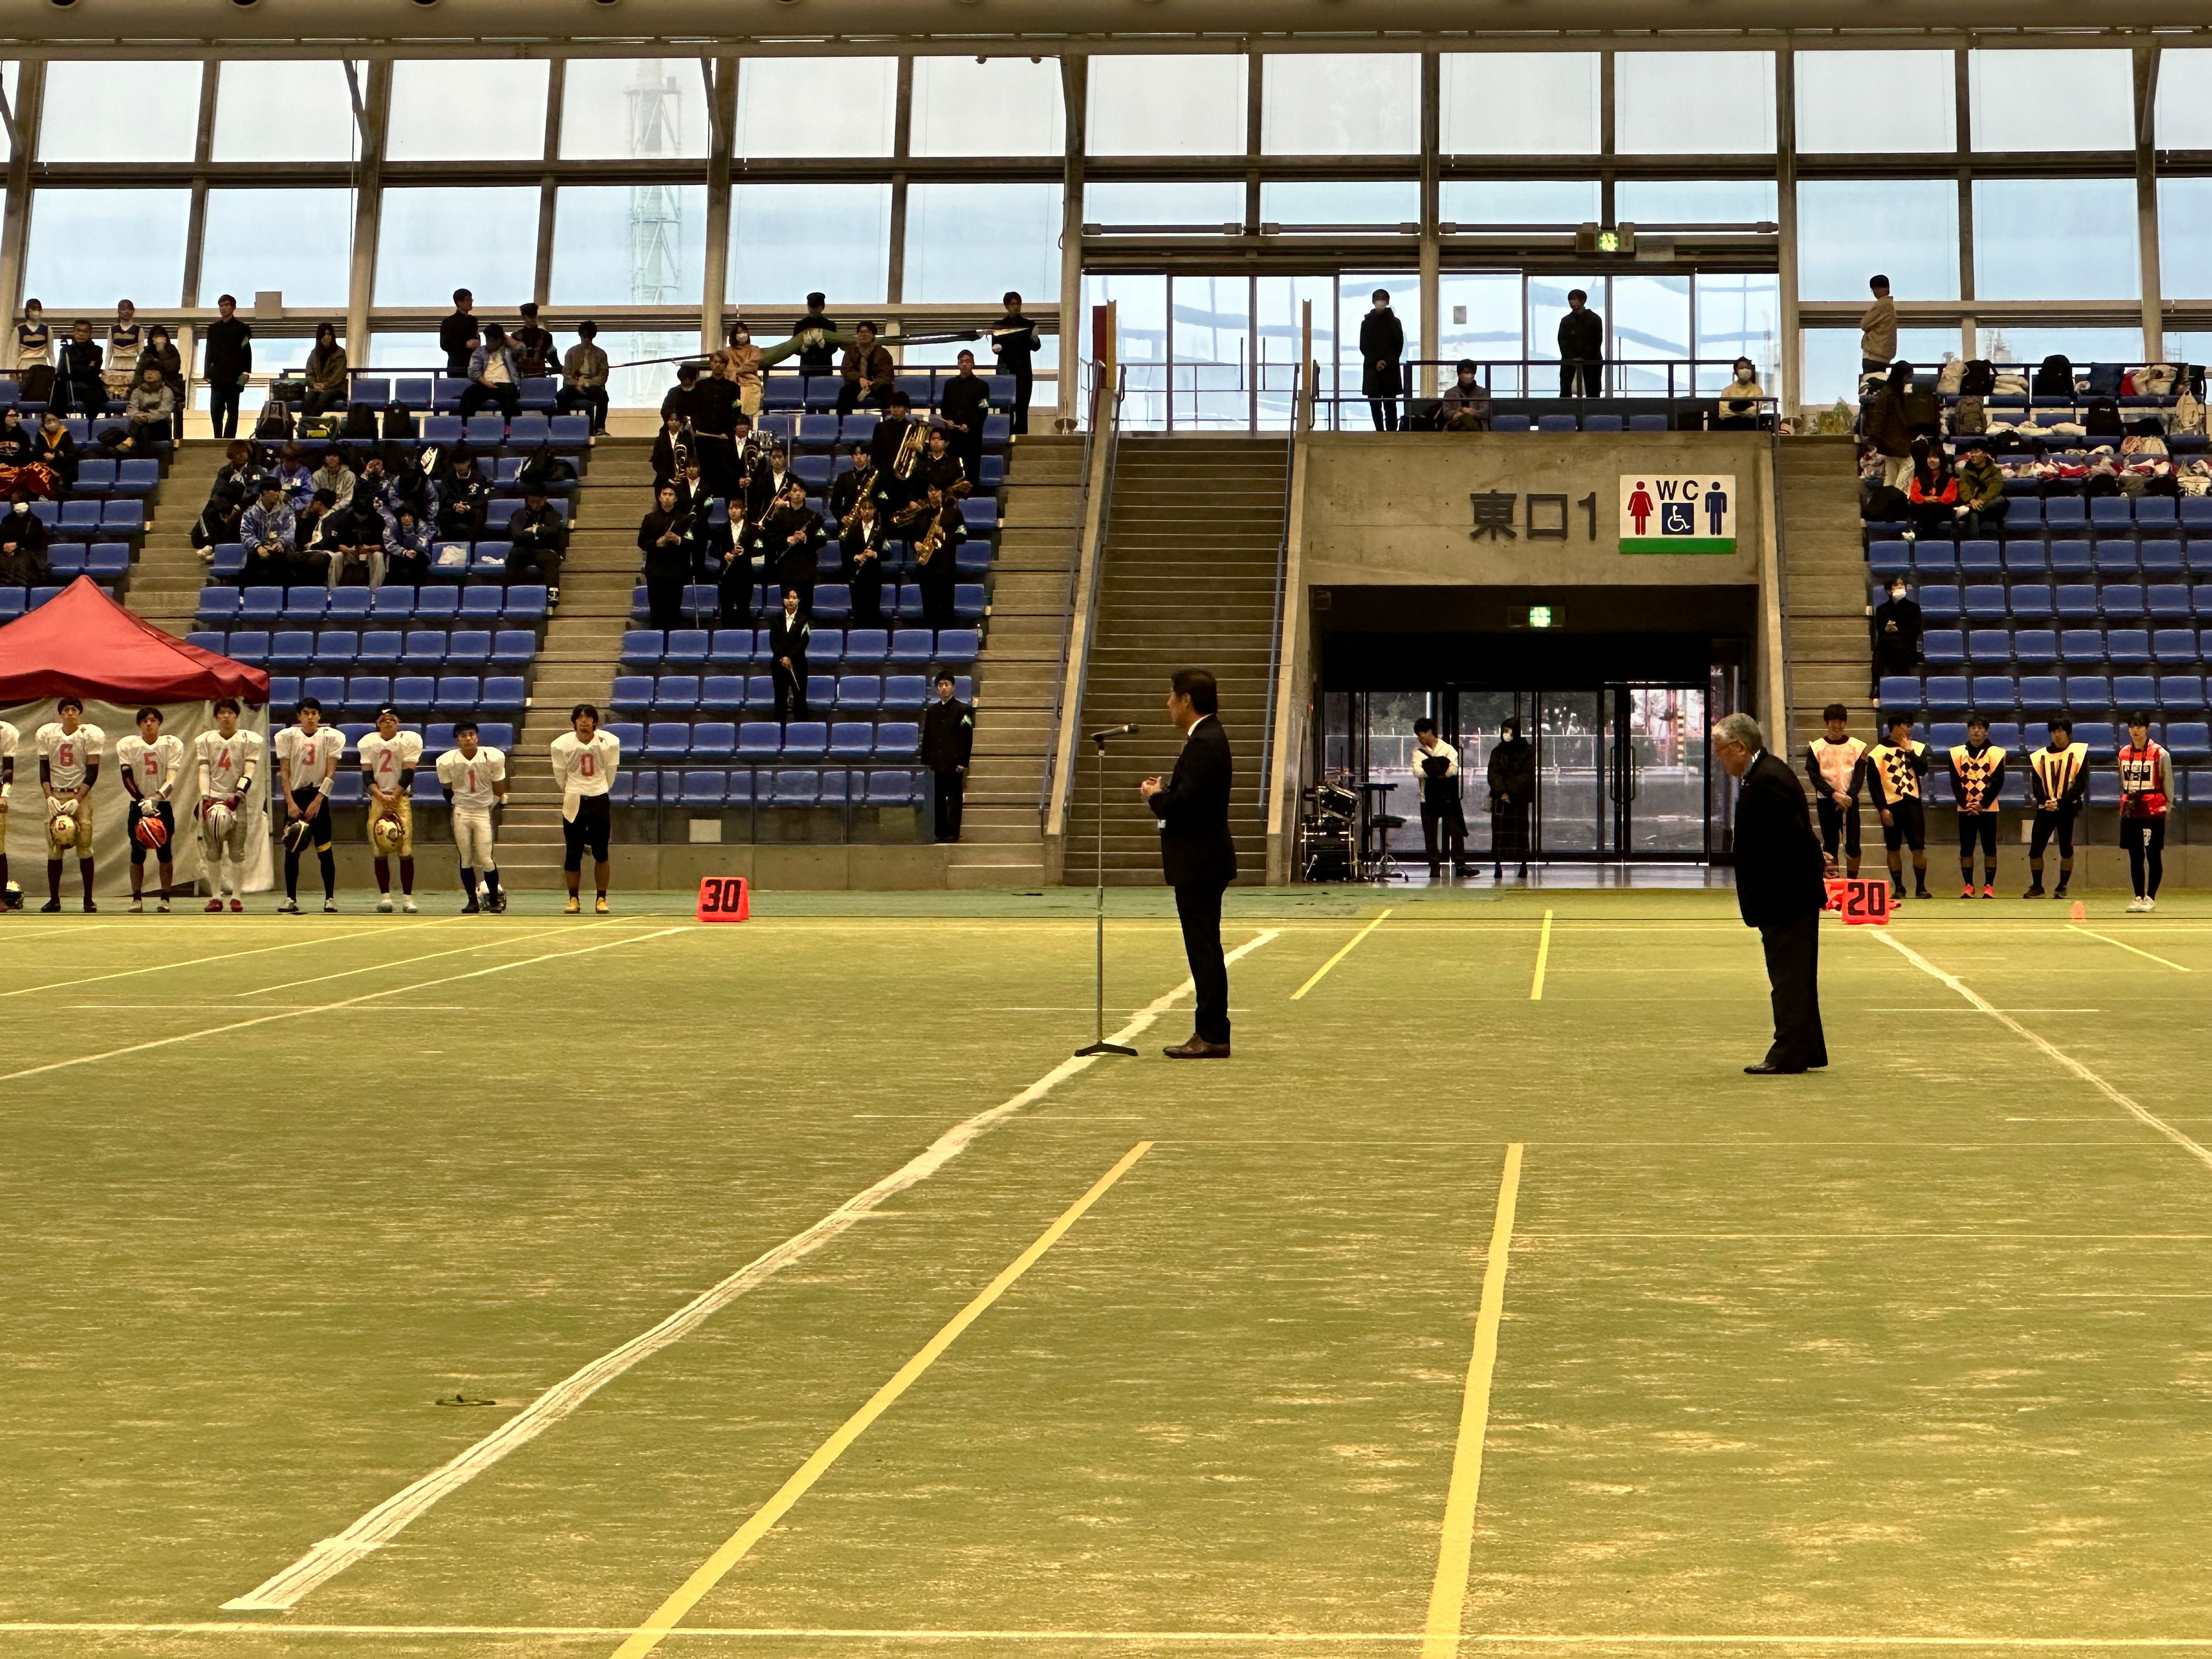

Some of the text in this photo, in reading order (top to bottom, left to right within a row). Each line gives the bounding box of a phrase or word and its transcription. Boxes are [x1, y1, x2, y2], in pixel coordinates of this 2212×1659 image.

[1656, 480, 1699, 501] WC
[59, 744, 74, 766] 6
[144, 753, 159, 775] 5
[218, 749, 232, 771] 4
[302, 743, 316, 766] 3
[380, 750, 392, 773] 2
[580, 753, 595, 777] 0
[469, 771, 476, 792] 1
[702, 879, 741, 912] 30
[1848, 882, 1885, 916] 20
